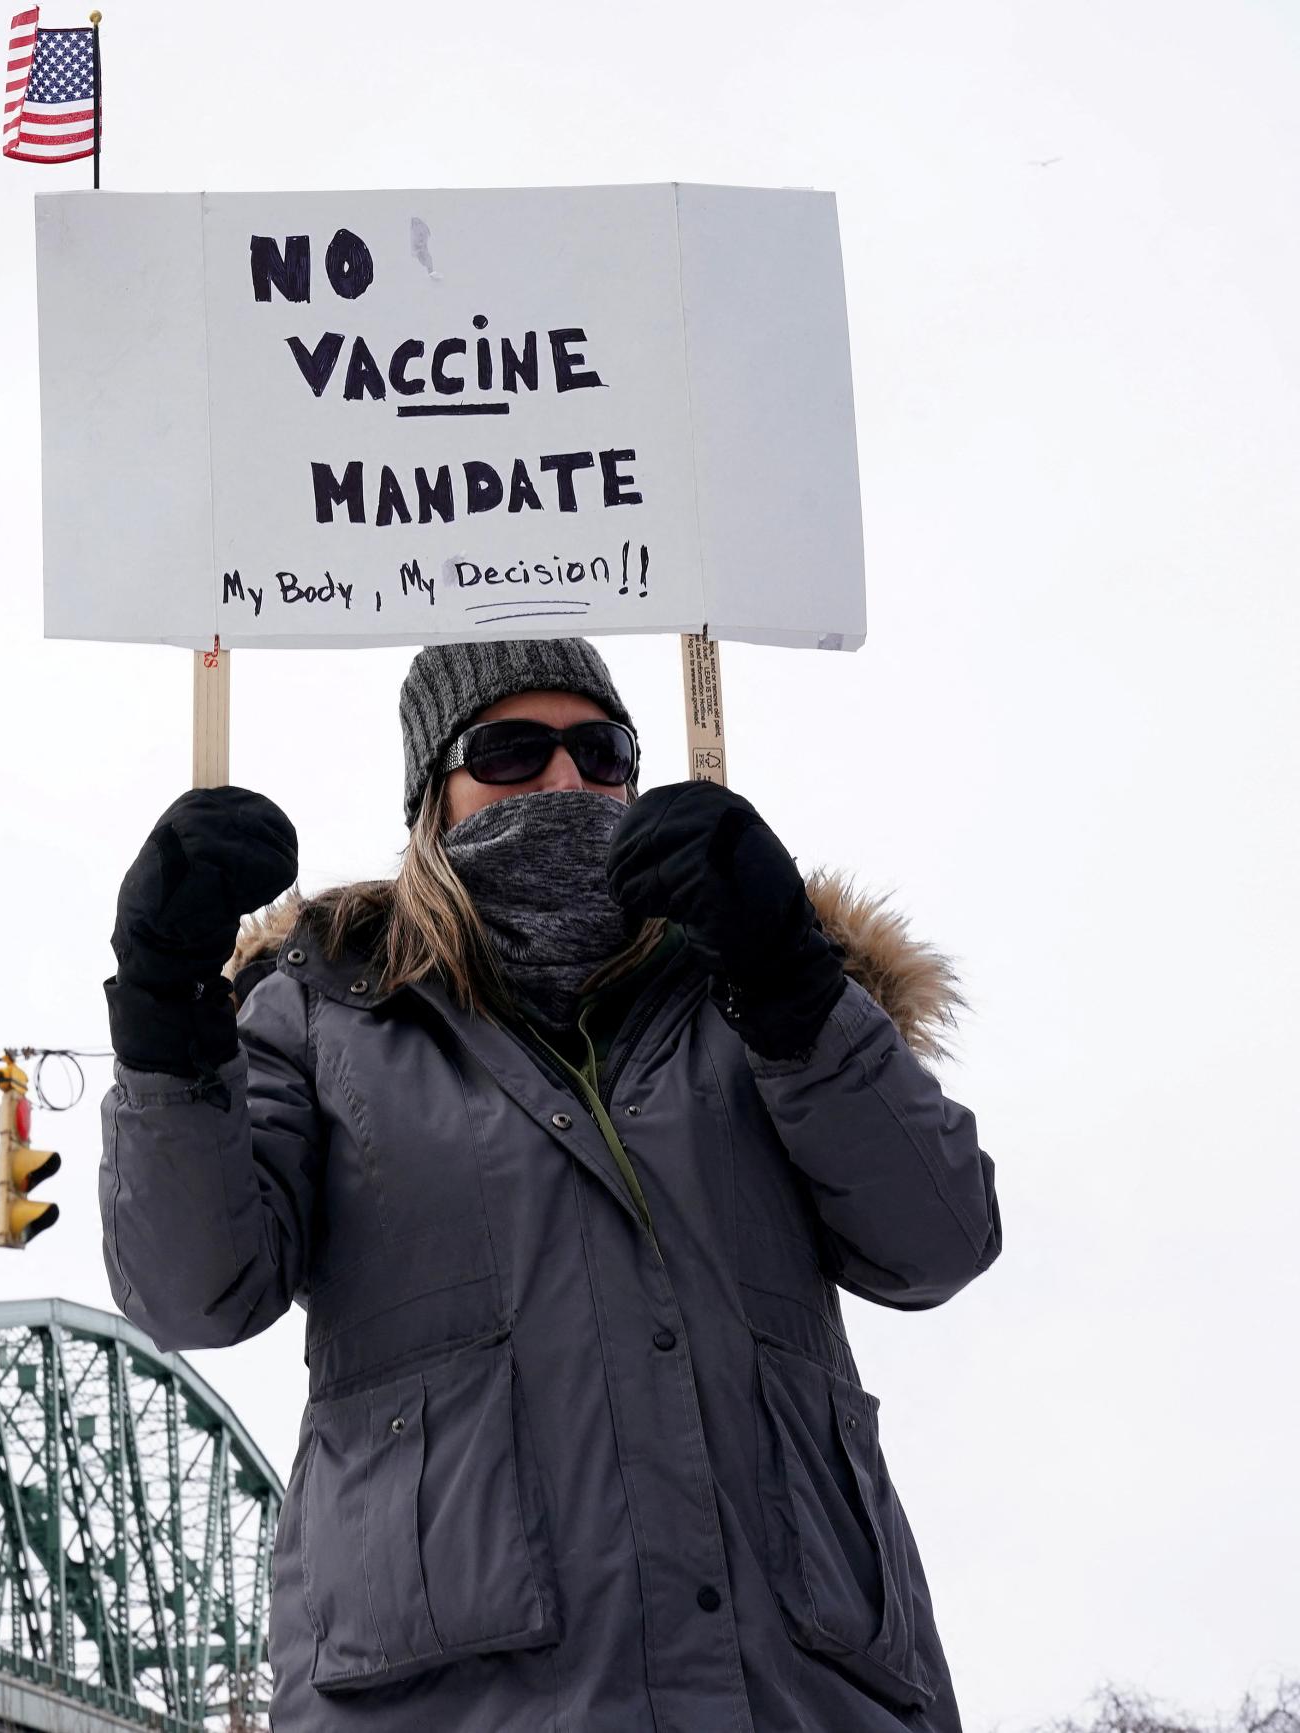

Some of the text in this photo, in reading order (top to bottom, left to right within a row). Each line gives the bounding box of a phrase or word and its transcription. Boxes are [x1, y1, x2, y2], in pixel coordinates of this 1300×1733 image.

[250, 229, 374, 303] NO
[311, 449, 643, 526] MANDATE
[222, 569, 263, 617] My
[399, 559, 435, 606] My
